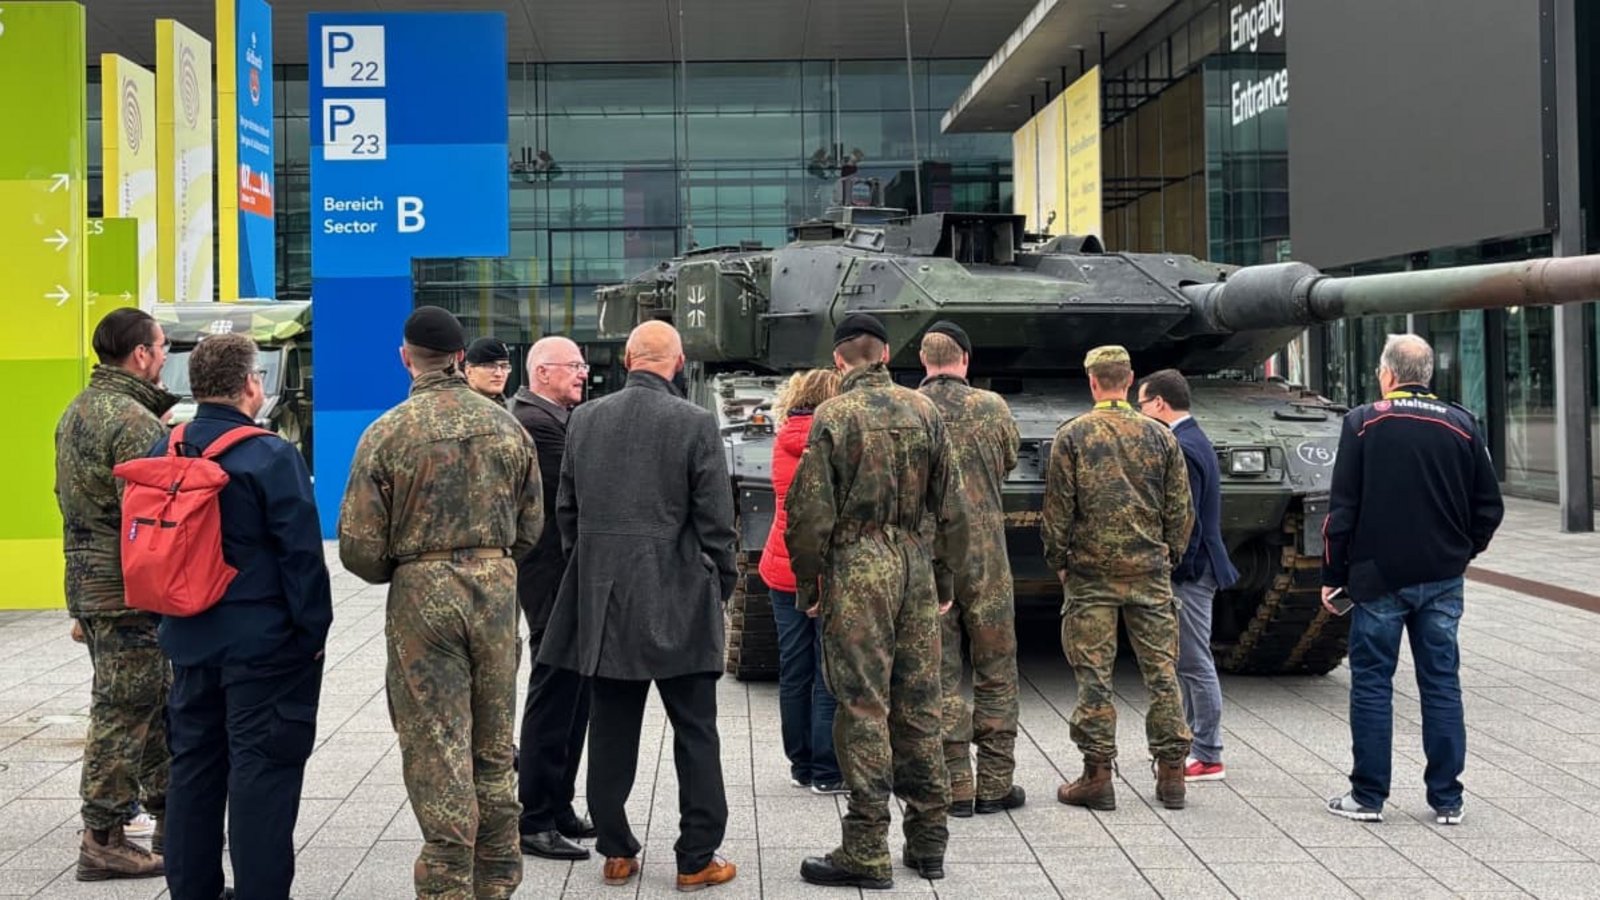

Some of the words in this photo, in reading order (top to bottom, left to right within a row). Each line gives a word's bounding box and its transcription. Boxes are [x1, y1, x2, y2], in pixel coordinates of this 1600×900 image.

[1230, 0, 1284, 52] Eingang
[328, 32, 354, 69] P
[350, 61, 379, 81] 22
[1231, 68, 1289, 126] Entrance
[329, 105, 355, 142] P
[351, 134, 380, 154] 23
[323, 196, 384, 211] Bereich
[397, 196, 426, 233] B
[323, 219, 378, 234] Sector
[1393, 398, 1447, 414] Malteser
[1302, 446, 1329, 460] 76
